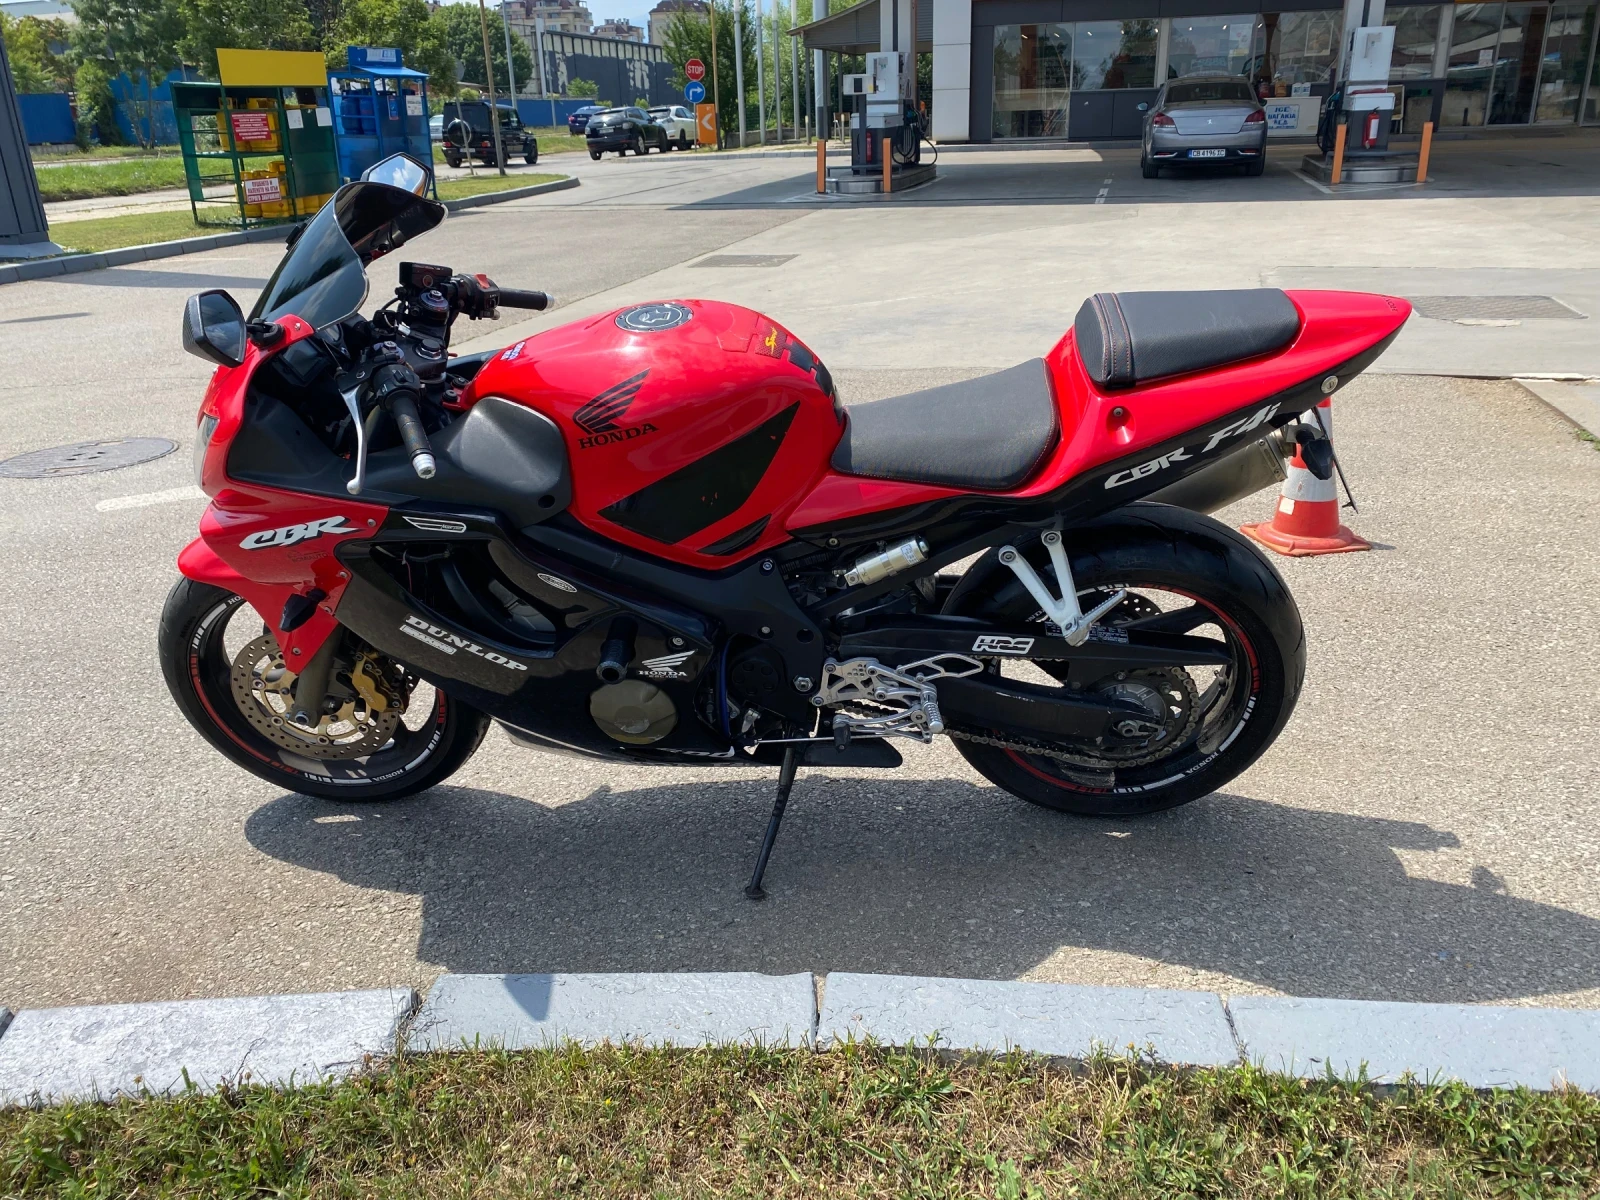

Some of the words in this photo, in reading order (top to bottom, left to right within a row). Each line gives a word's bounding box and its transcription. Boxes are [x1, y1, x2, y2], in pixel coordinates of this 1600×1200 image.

[687, 65, 703, 74] STOP
[578, 422, 659, 450] HONDA
[1104, 446, 1194, 490] CBR
[239, 515, 361, 550] CBR
[406, 615, 529, 671] DUNLOP
[372, 769, 404, 782] HONDA
[1185, 751, 1220, 774] HONDA
